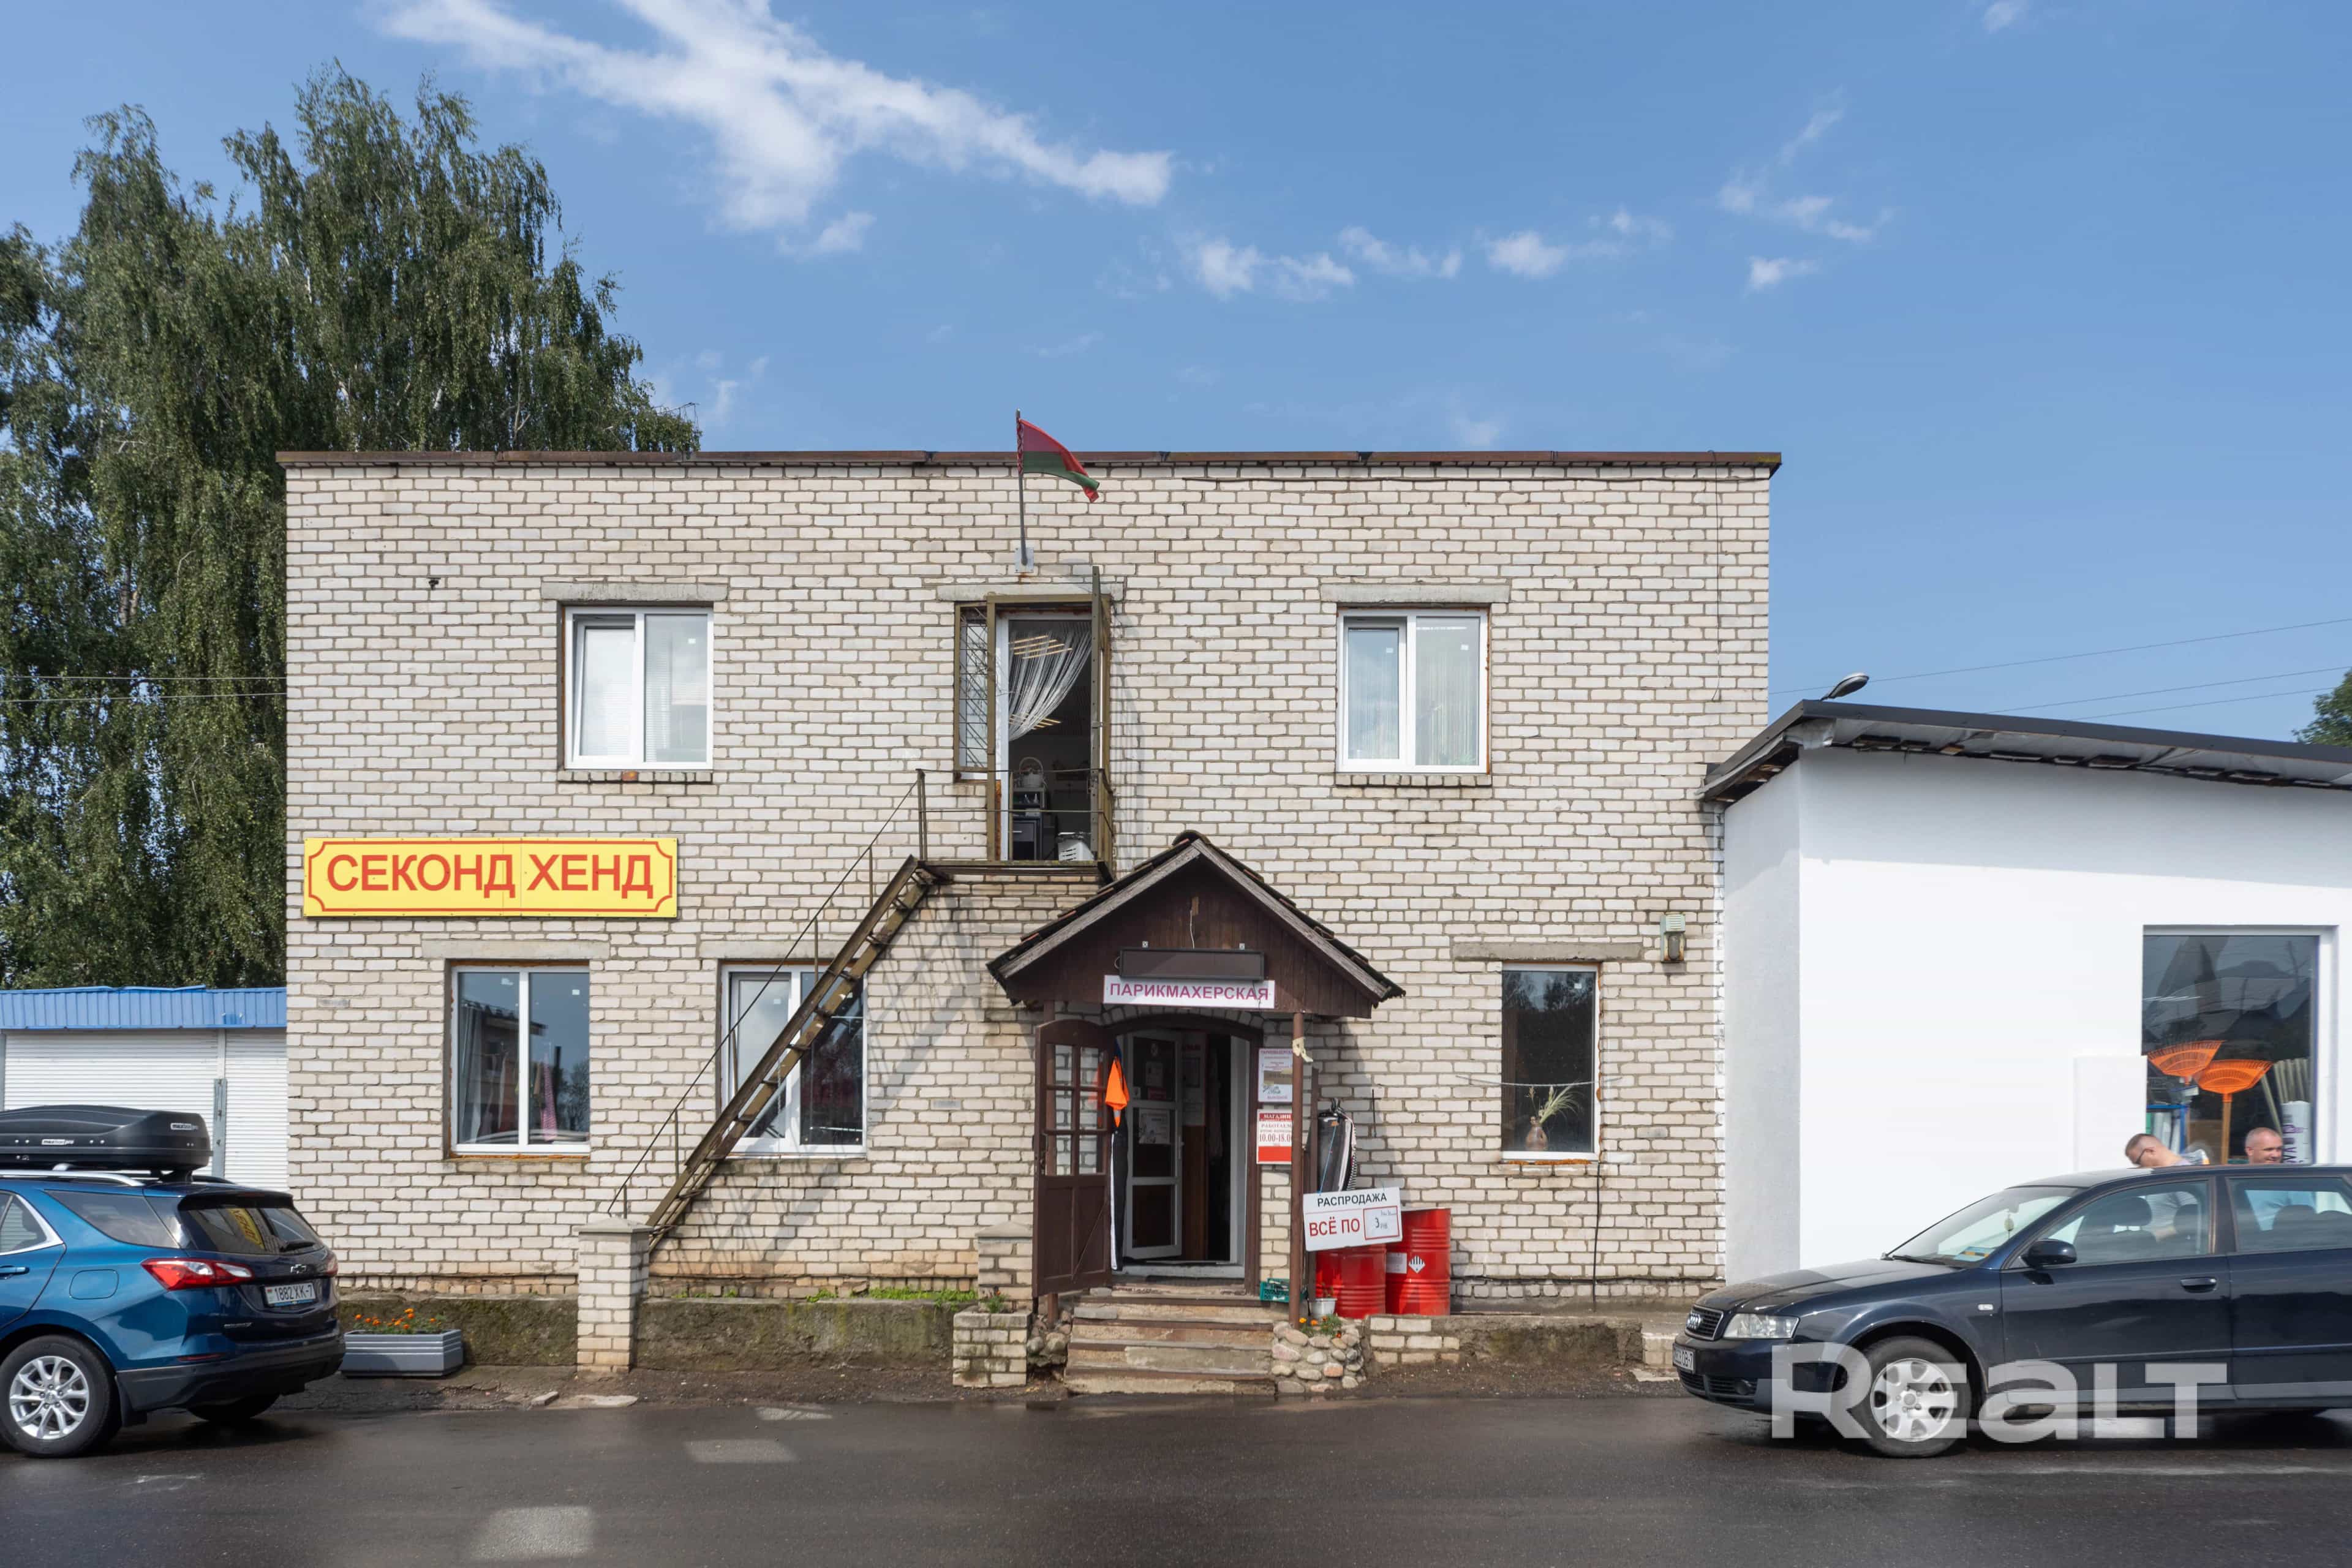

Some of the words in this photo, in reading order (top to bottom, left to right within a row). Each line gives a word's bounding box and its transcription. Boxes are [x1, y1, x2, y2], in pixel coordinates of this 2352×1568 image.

[327, 854, 515, 899] СЕКОНД
[527, 854, 654, 899] ХЕНД
[1110, 982, 1268, 1001] ПАРИКМАХЕРСКАЯ
[1259, 1133, 1292, 1142] 10.00-18.0
[1317, 1193, 1387, 1207] РАСПРОДАЖА
[1309, 1216, 1337, 1237] ВСЁ
[1341, 1218, 1360, 1234] ПО
[274, 1287, 293, 1301] 1882
